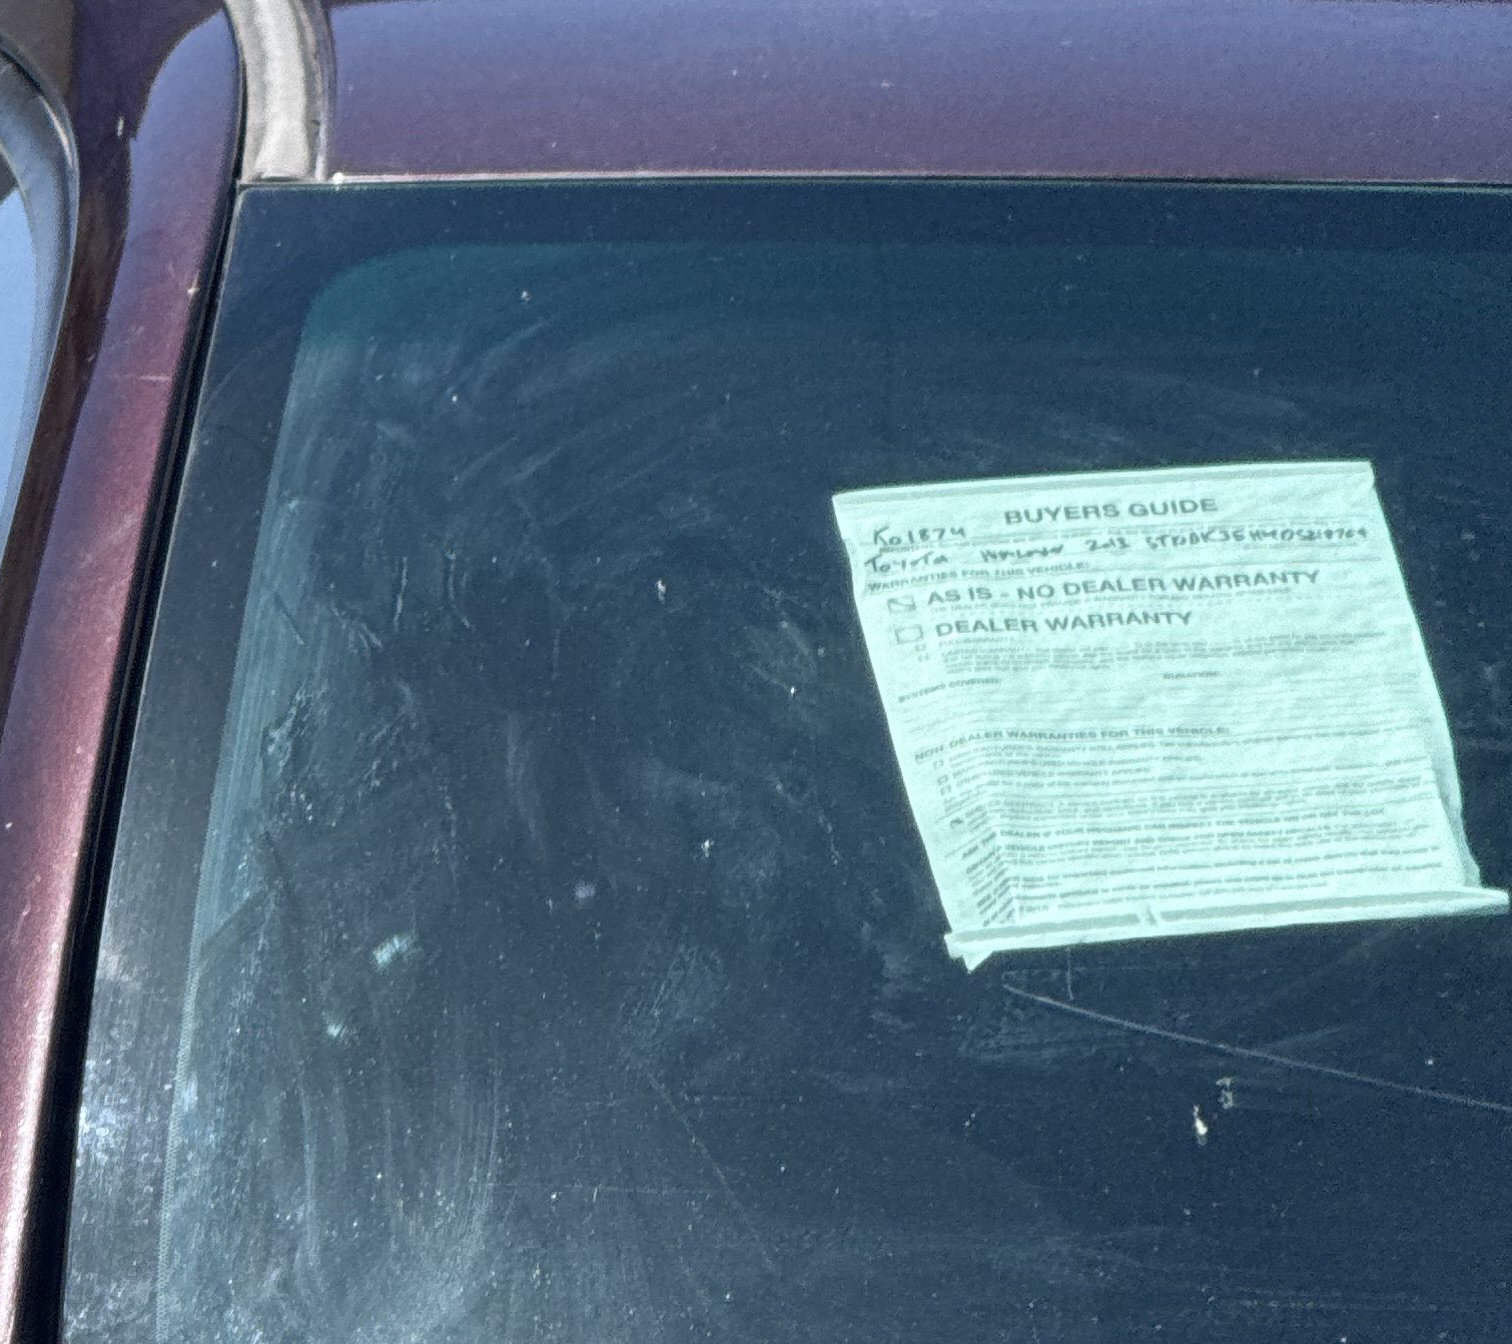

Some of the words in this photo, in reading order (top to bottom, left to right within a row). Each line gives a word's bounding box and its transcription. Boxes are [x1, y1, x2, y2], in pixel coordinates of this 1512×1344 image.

[1004, 503, 1120, 525] BUYERS
[1128, 498, 1219, 517] GUIDE
[868, 570, 958, 592] WARRANTIES
[961, 568, 990, 577] FOR
[928, 588, 961, 606] AS
[968, 586, 993, 601] IS
[1017, 584, 1056, 602] NO
[1063, 577, 1167, 596] DEALER
[1172, 569, 1320, 592] WARRANTY
[935, 617, 1038, 637] DEALER
[1044, 611, 1192, 632] WARRANTY
[1006, 730, 1098, 741] WARRANTIES
[1100, 729, 1130, 740] FOR
[1133, 727, 1164, 737] THIS
